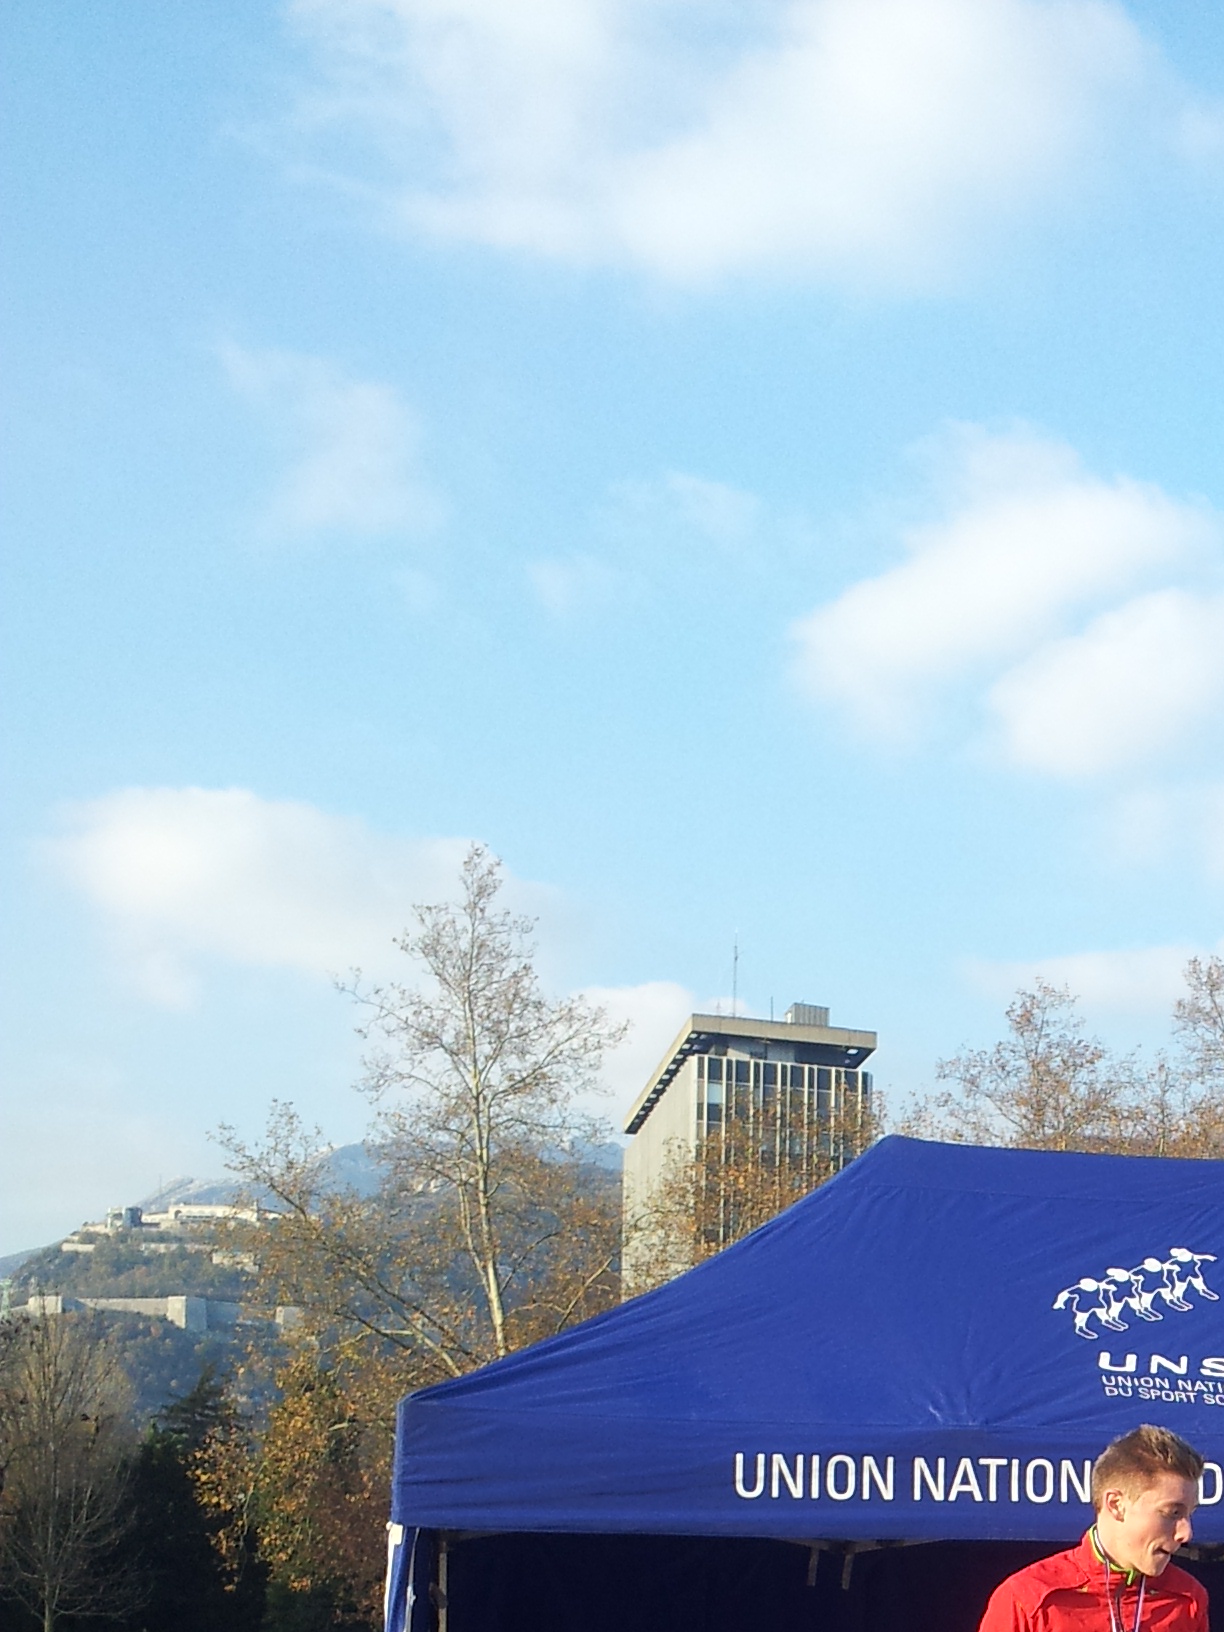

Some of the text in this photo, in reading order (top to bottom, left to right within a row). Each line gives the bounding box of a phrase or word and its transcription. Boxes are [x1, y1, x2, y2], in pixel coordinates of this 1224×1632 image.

[1102, 1375, 1170, 1389] UNION
[1105, 1387, 1132, 1397] DU
[1138, 1388, 1197, 1403] SPORT
[735, 1453, 895, 1500] UNION
[912, 1457, 1092, 1503] NATION
